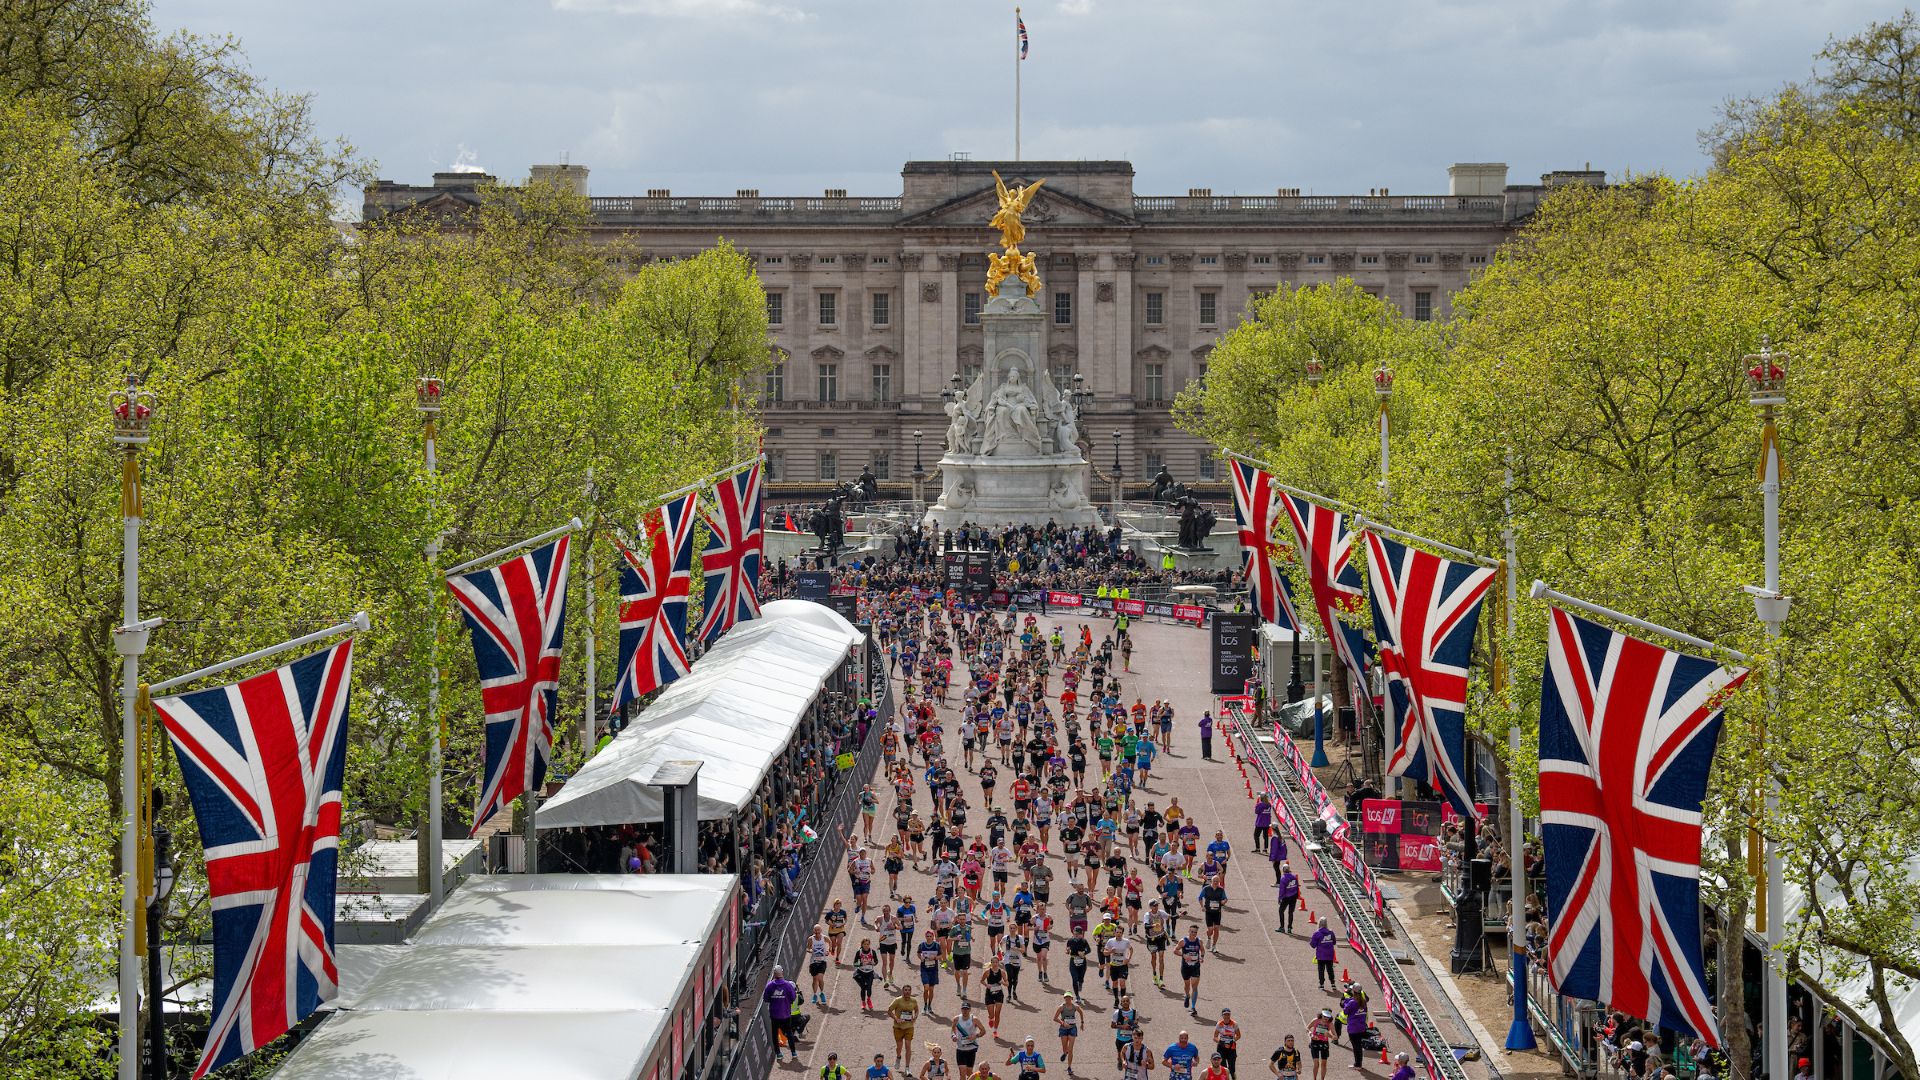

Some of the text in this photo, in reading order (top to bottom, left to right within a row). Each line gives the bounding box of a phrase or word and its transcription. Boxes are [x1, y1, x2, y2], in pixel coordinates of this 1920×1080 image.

[968, 566, 983, 575] tcs
[1221, 634, 1238, 645] tcs
[1221, 664, 1238, 675] tcs
[1367, 808, 1382, 822] tcs
[1412, 809, 1430, 827] tcs
[1447, 811, 1459, 824] tc
[1374, 841, 1388, 857] tcs
[1404, 843, 1418, 857] tcs
